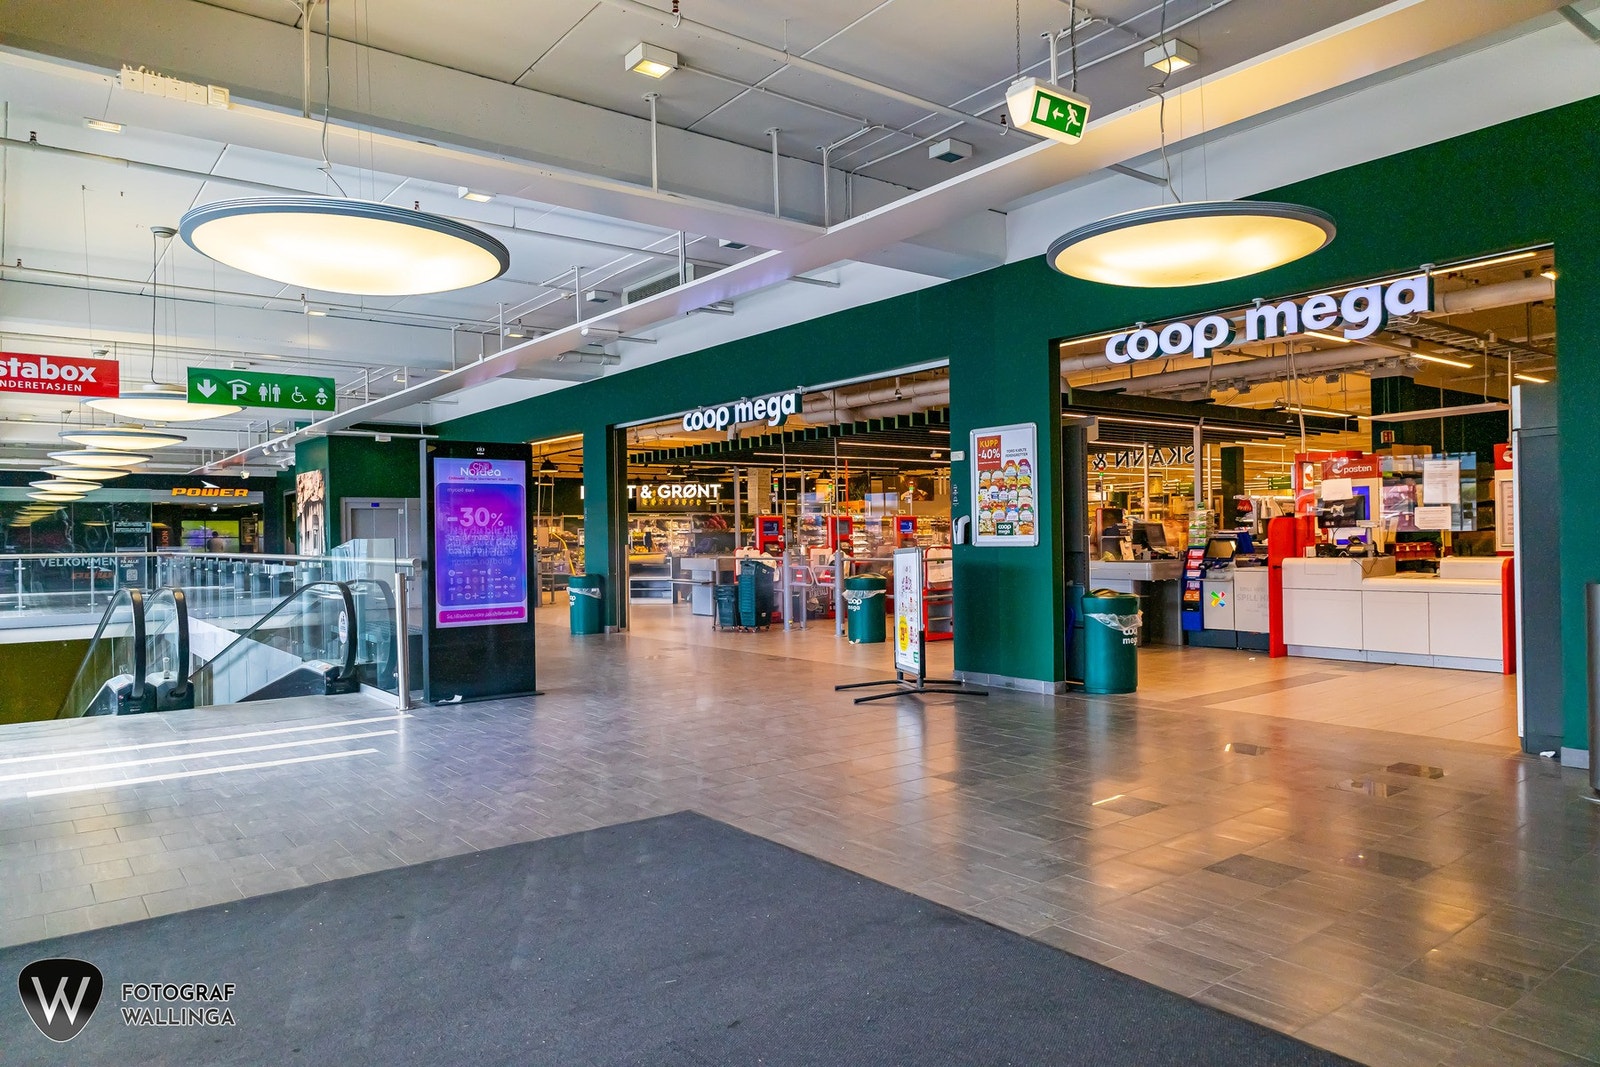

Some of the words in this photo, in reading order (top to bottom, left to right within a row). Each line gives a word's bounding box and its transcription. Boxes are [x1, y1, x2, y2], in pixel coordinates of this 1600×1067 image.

[1105, 315, 1230, 364] coop
[1246, 276, 1428, 341] mega
[683, 406, 730, 432] coop
[735, 393, 796, 427] mega
[979, 439, 999, 448] KUPP
[977, 448, 1001, 459] -40%
[460, 467, 502, 477] Nordea
[1343, 465, 1372, 475] posten
[171, 487, 249, 498] POWER
[657, 484, 722, 499] GRØNT
[447, 507, 504, 528] -30%
[40, 557, 116, 568] VELKOMMEN
